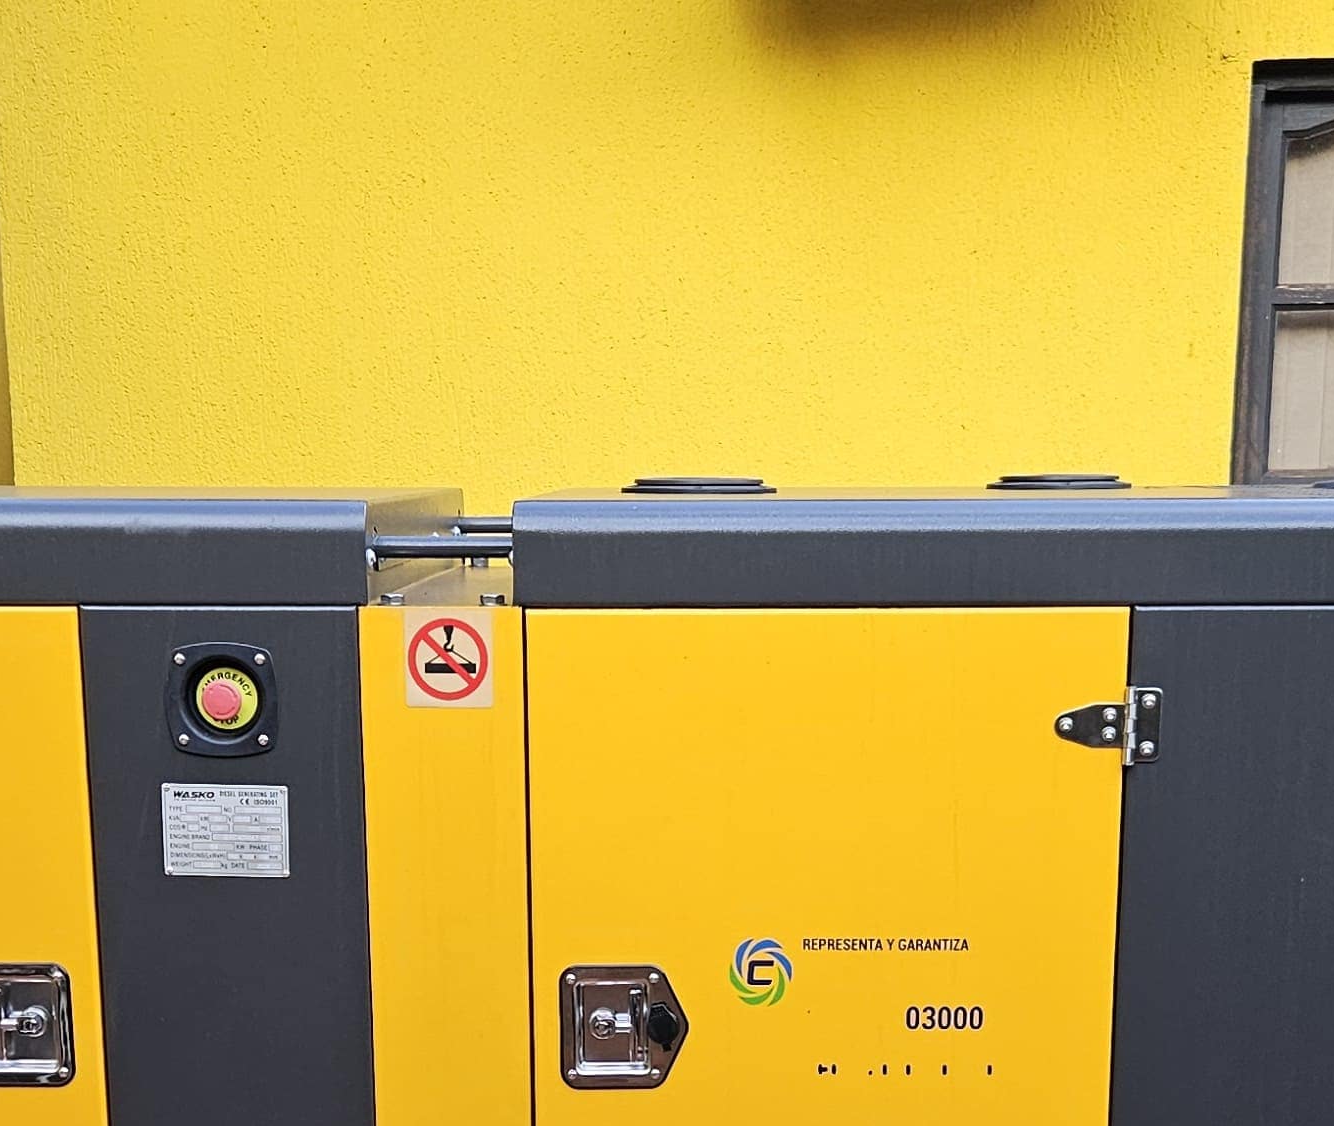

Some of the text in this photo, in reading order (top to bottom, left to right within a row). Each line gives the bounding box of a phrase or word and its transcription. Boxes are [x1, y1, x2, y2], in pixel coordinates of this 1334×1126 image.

[173, 791, 215, 799] WASKO
[803, 938, 969, 951] REPRESENTA Y GARANTIZA
[905, 1006, 984, 1030] 03000
